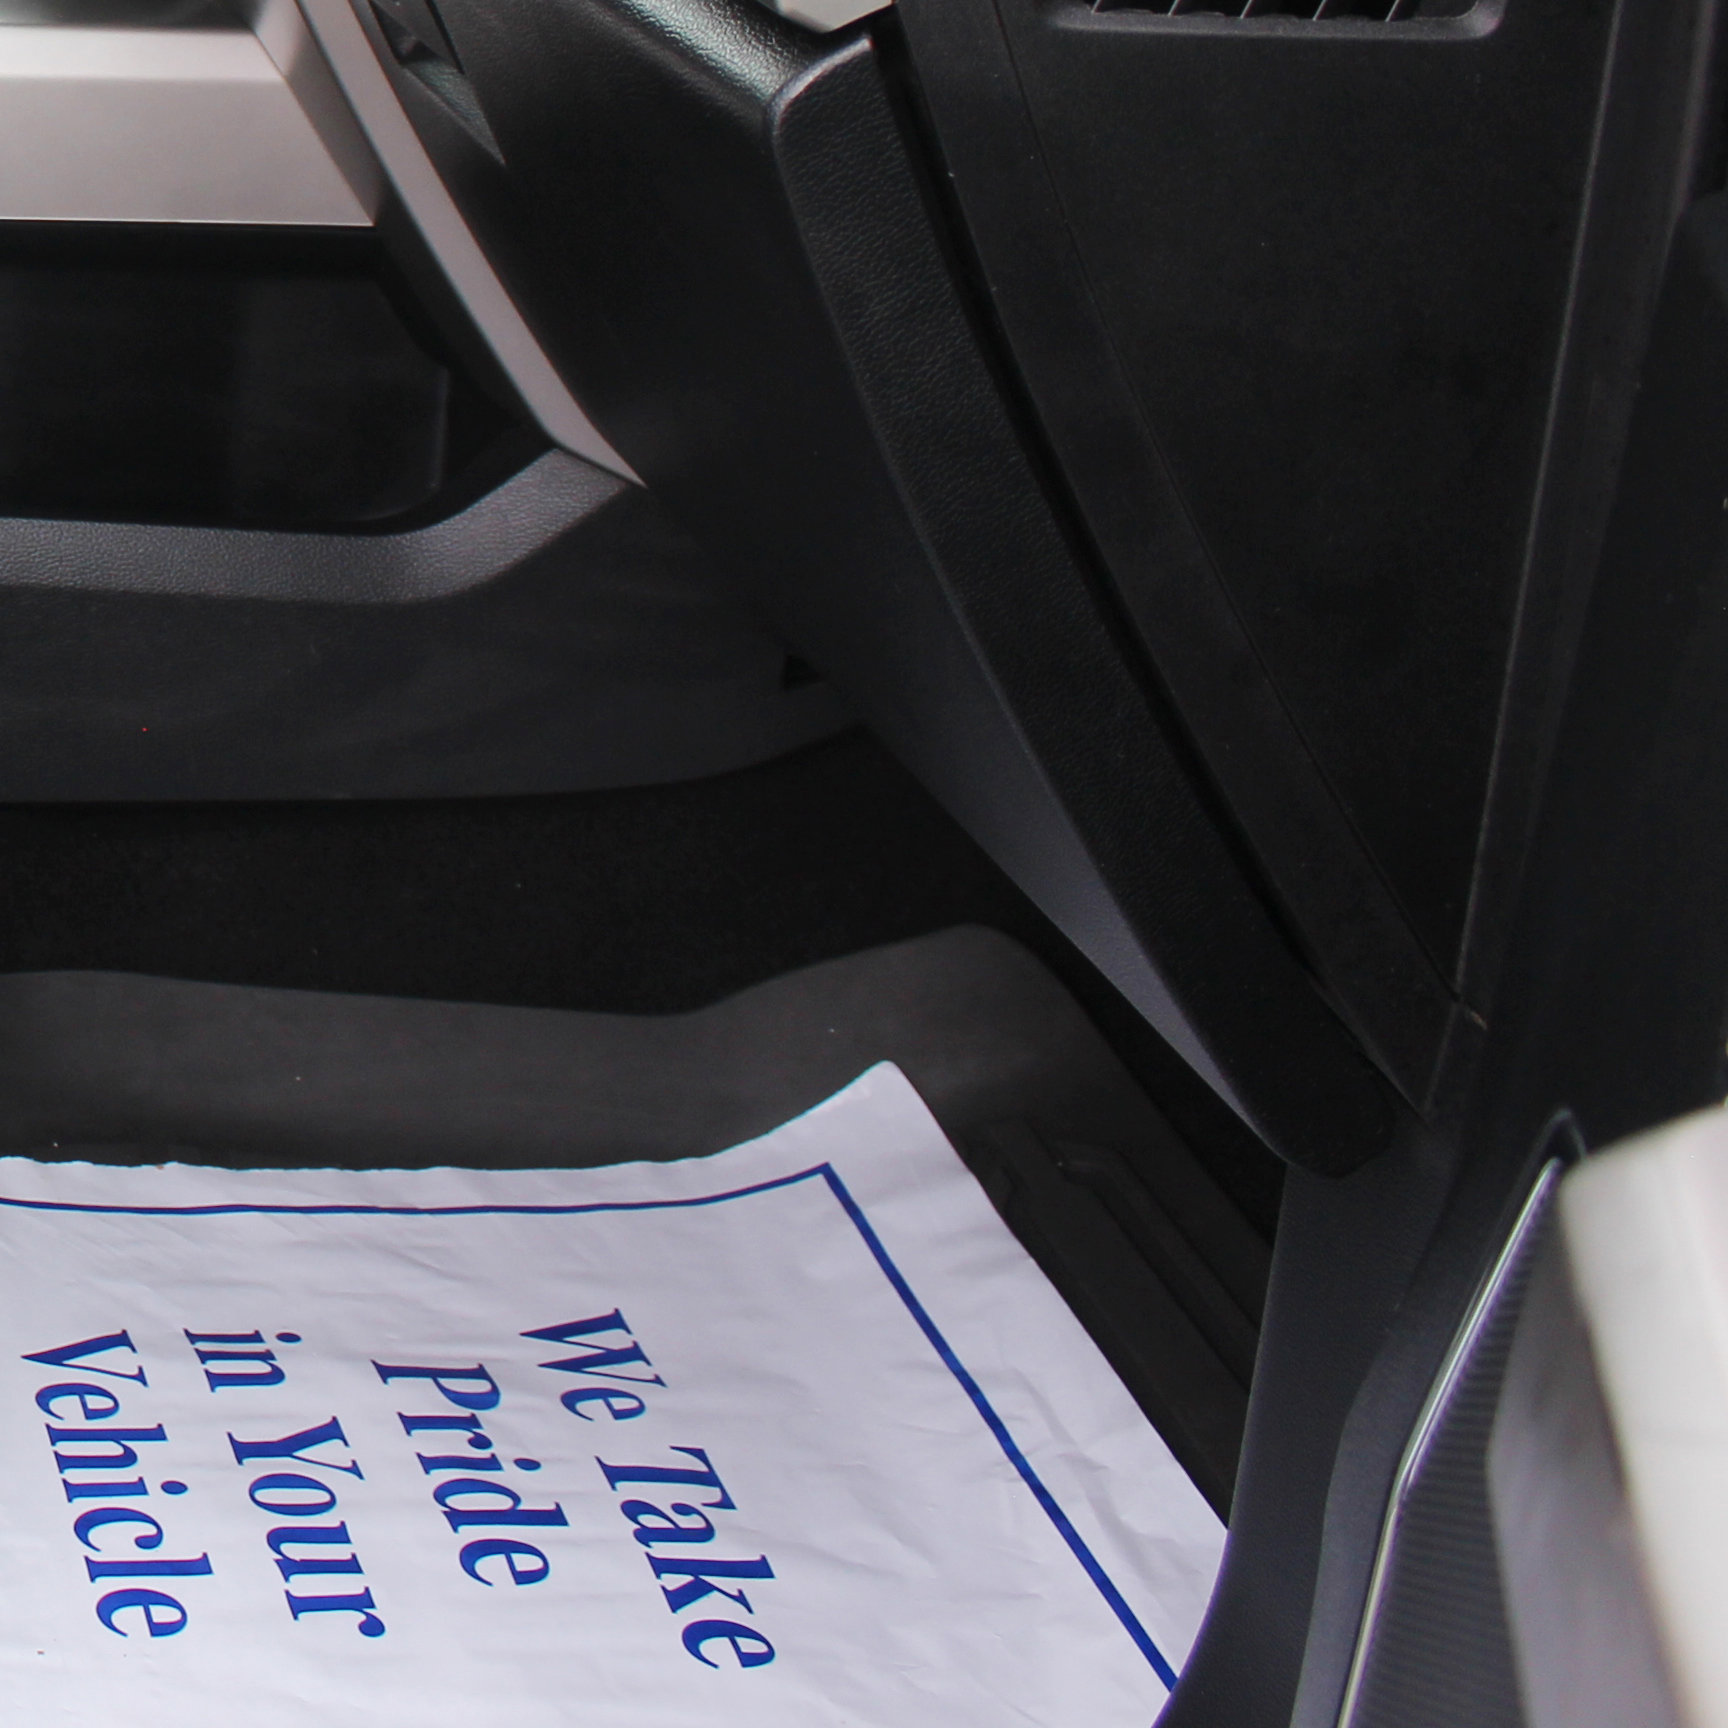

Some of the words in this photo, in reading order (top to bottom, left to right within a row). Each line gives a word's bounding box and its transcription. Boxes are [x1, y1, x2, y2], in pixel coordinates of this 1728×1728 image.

[183, 1327, 302, 1393] in
[370, 1358, 570, 1587] Pride
[20, 1328, 215, 1638] Vehicle
[226, 1415, 386, 1638] Your
[519, 1307, 668, 1422] We
[595, 1445, 776, 1670] Take
